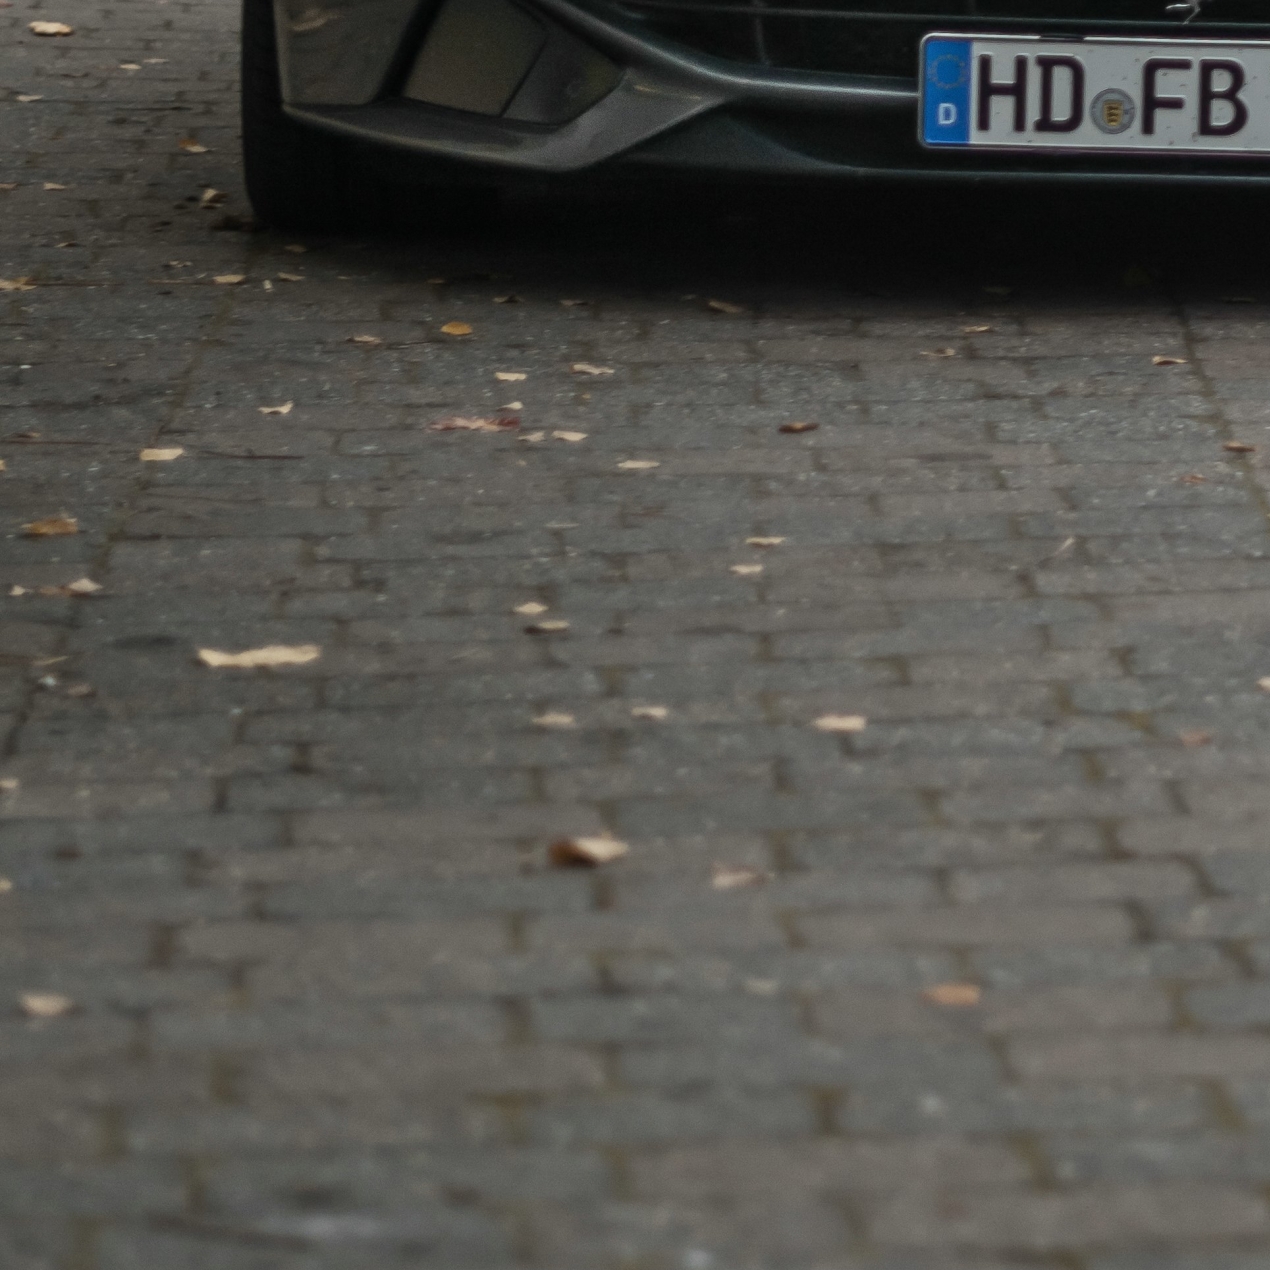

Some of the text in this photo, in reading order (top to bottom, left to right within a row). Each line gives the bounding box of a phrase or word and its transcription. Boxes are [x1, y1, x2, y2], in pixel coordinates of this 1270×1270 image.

[938, 103, 957, 126] D
[976, 52, 1086, 134] HD
[1140, 57, 1249, 138] FB
